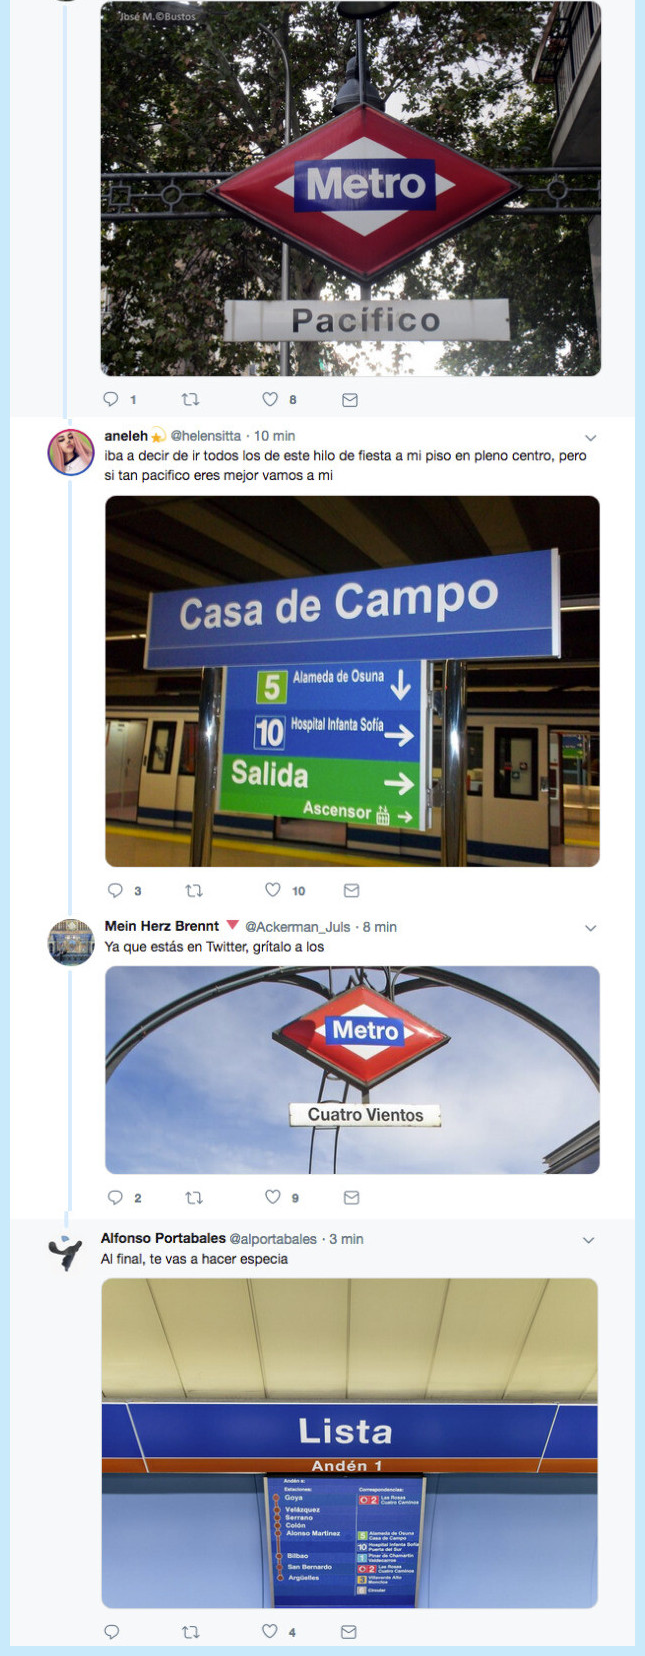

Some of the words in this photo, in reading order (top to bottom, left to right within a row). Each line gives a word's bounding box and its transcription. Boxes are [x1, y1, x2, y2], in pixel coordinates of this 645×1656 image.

[307, 167, 426, 200] Metro
[292, 307, 440, 333] Pacífico
[180, 597, 262, 630] Casa
[276, 588, 321, 624] de
[335, 578, 498, 623] Campo
[264, 674, 280, 700] 5
[293, 670, 334, 684] Alameda
[337, 670, 348, 683] de
[351, 669, 384, 683] Osuna
[256, 718, 284, 747] 10
[291, 717, 325, 733] Hospital
[328, 717, 358, 732] Infanta
[360, 717, 384, 732] Sofía
[231, 759, 308, 789] Salida
[303, 800, 372, 820] Ascensor
[333, 1020, 399, 1040] Metro
[308, 1107, 362, 1122] Cuatro
[366, 1108, 424, 1122] Vientos
[99, 1252, 113, 1265] Al
[115, 1252, 146, 1267] final,
[148, 1253, 162, 1265] te
[164, 1254, 187, 1265] vas
[189, 1254, 198, 1265] a
[201, 1252, 237, 1265] hacer
[239, 1252, 288, 1268] especia
[299, 1418, 392, 1444] Lista
[312, 1460, 367, 1472] Andén
[374, 1460, 382, 1471] 1
[284, 1494, 303, 1502] Goya
